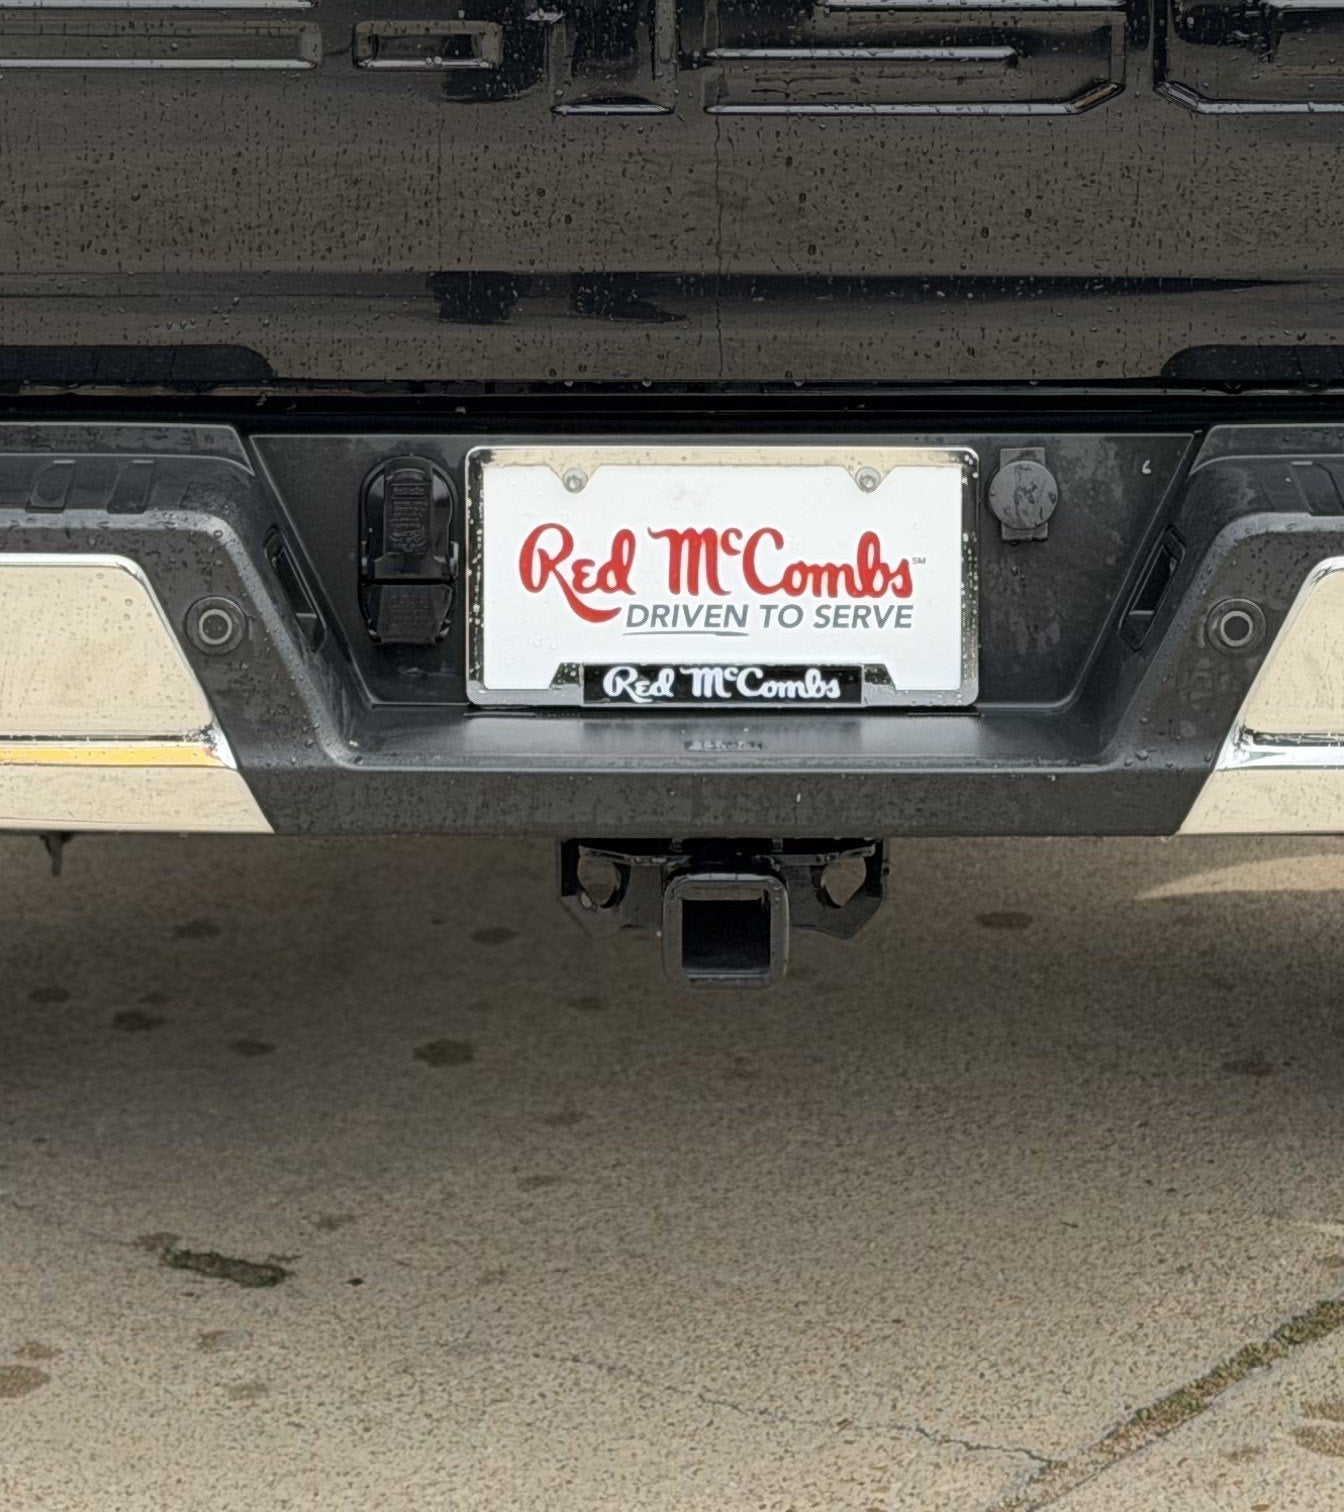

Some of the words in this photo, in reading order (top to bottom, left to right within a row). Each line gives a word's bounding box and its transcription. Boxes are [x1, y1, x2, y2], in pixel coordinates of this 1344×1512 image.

[519, 522, 637, 624] Red
[647, 526, 914, 599] McCombs
[625, 603, 750, 629] DRIVEN
[759, 603, 804, 629] TO
[812, 603, 914, 629] SERVE
[602, 665, 675, 703] Red
[679, 666, 842, 699] McCombs
